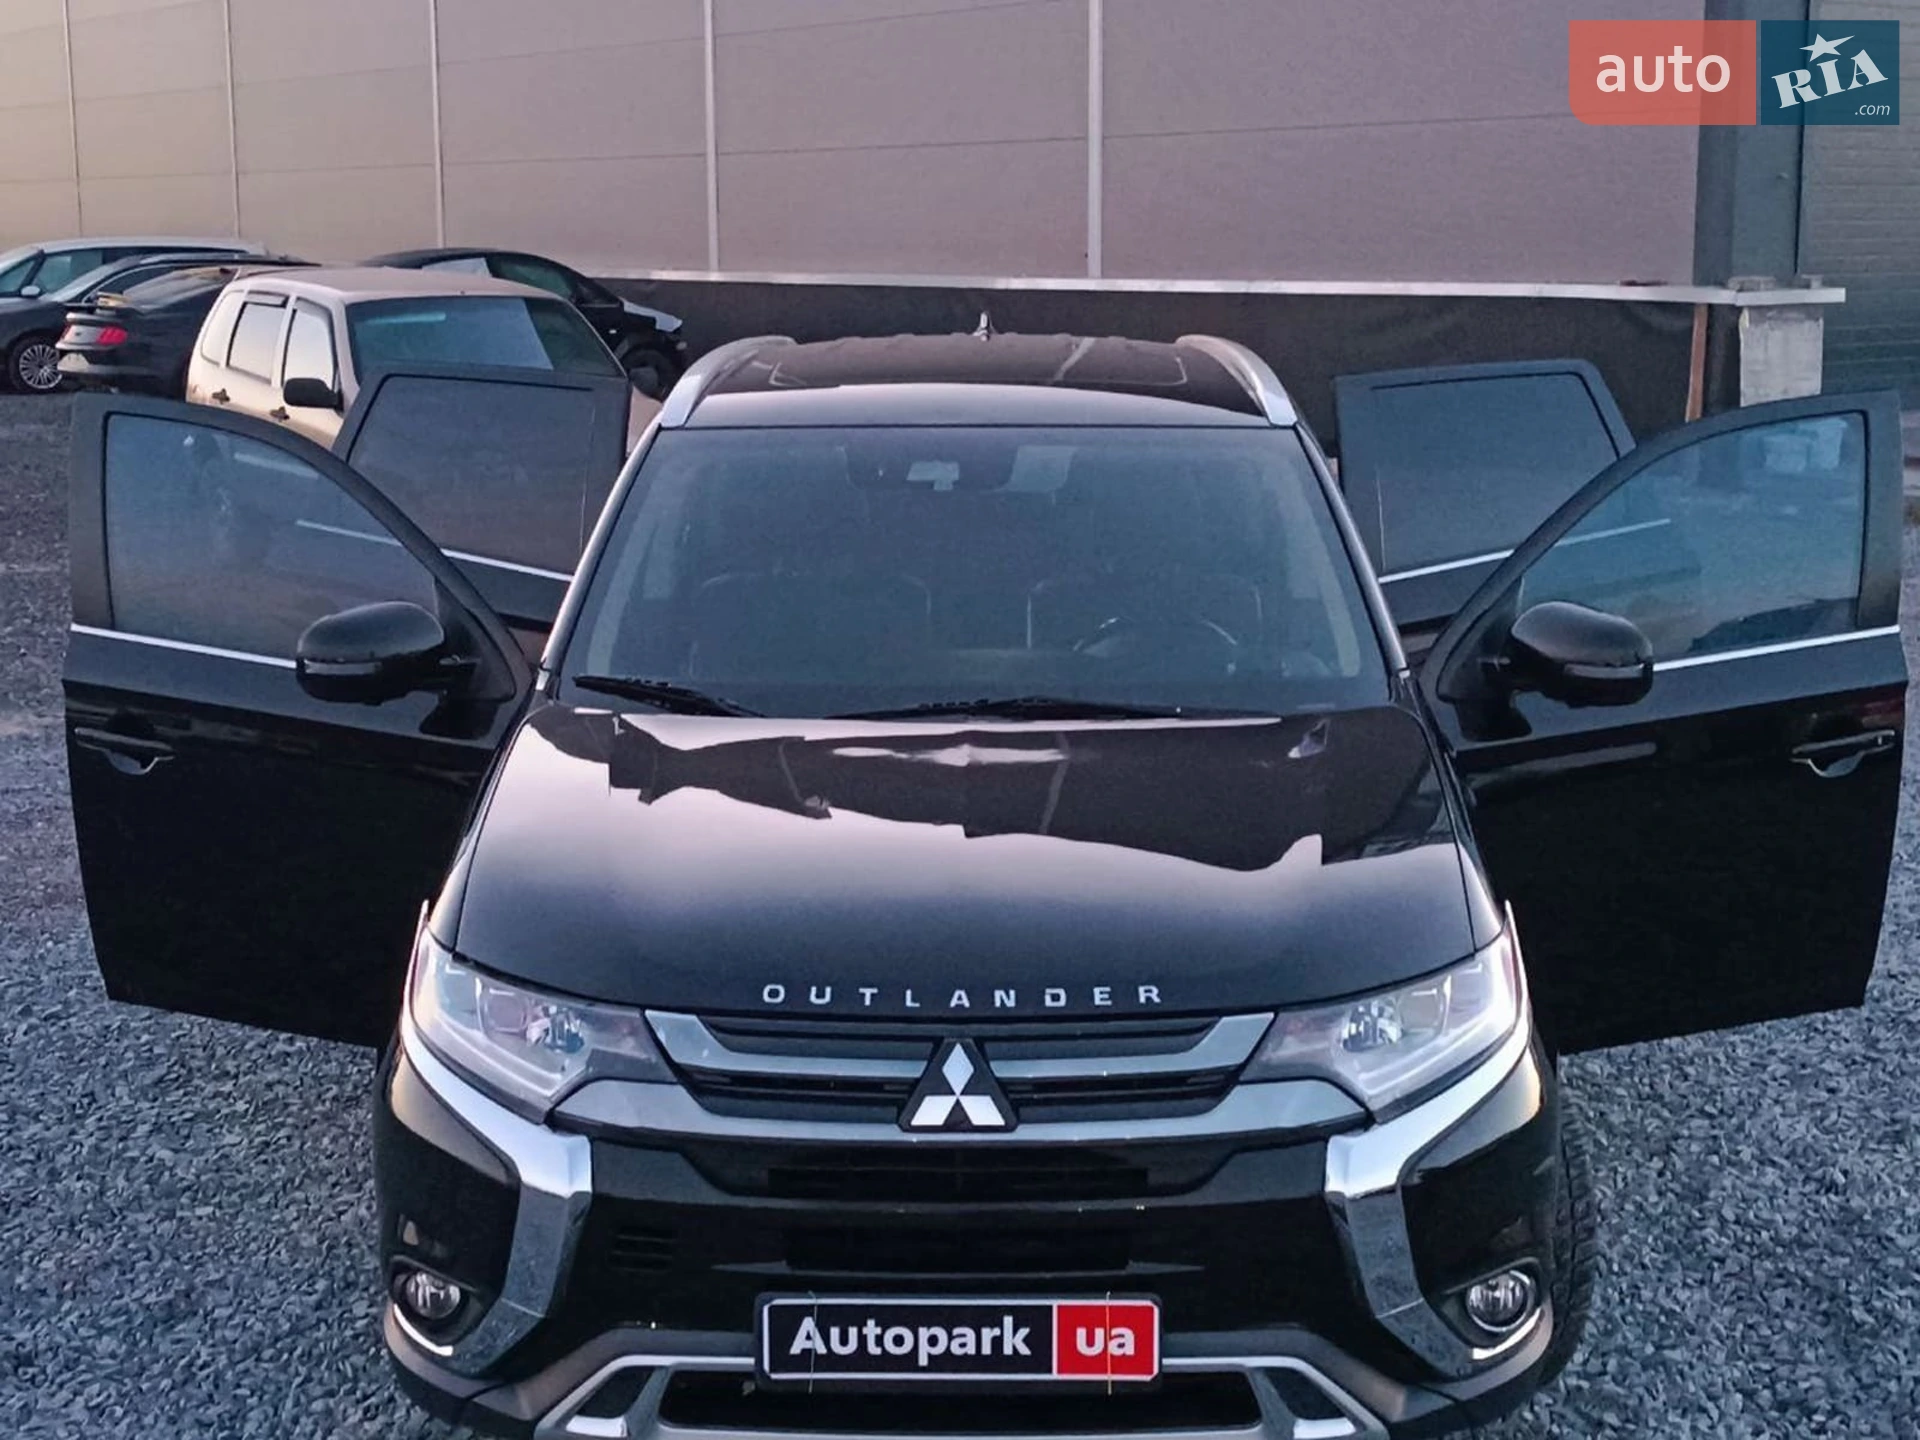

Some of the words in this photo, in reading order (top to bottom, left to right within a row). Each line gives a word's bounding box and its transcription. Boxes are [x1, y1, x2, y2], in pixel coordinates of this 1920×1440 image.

[762, 984, 1161, 1008] OUTLANDER
[789, 1315, 1032, 1367] Autopark
[1075, 1326, 1135, 1357] ua
